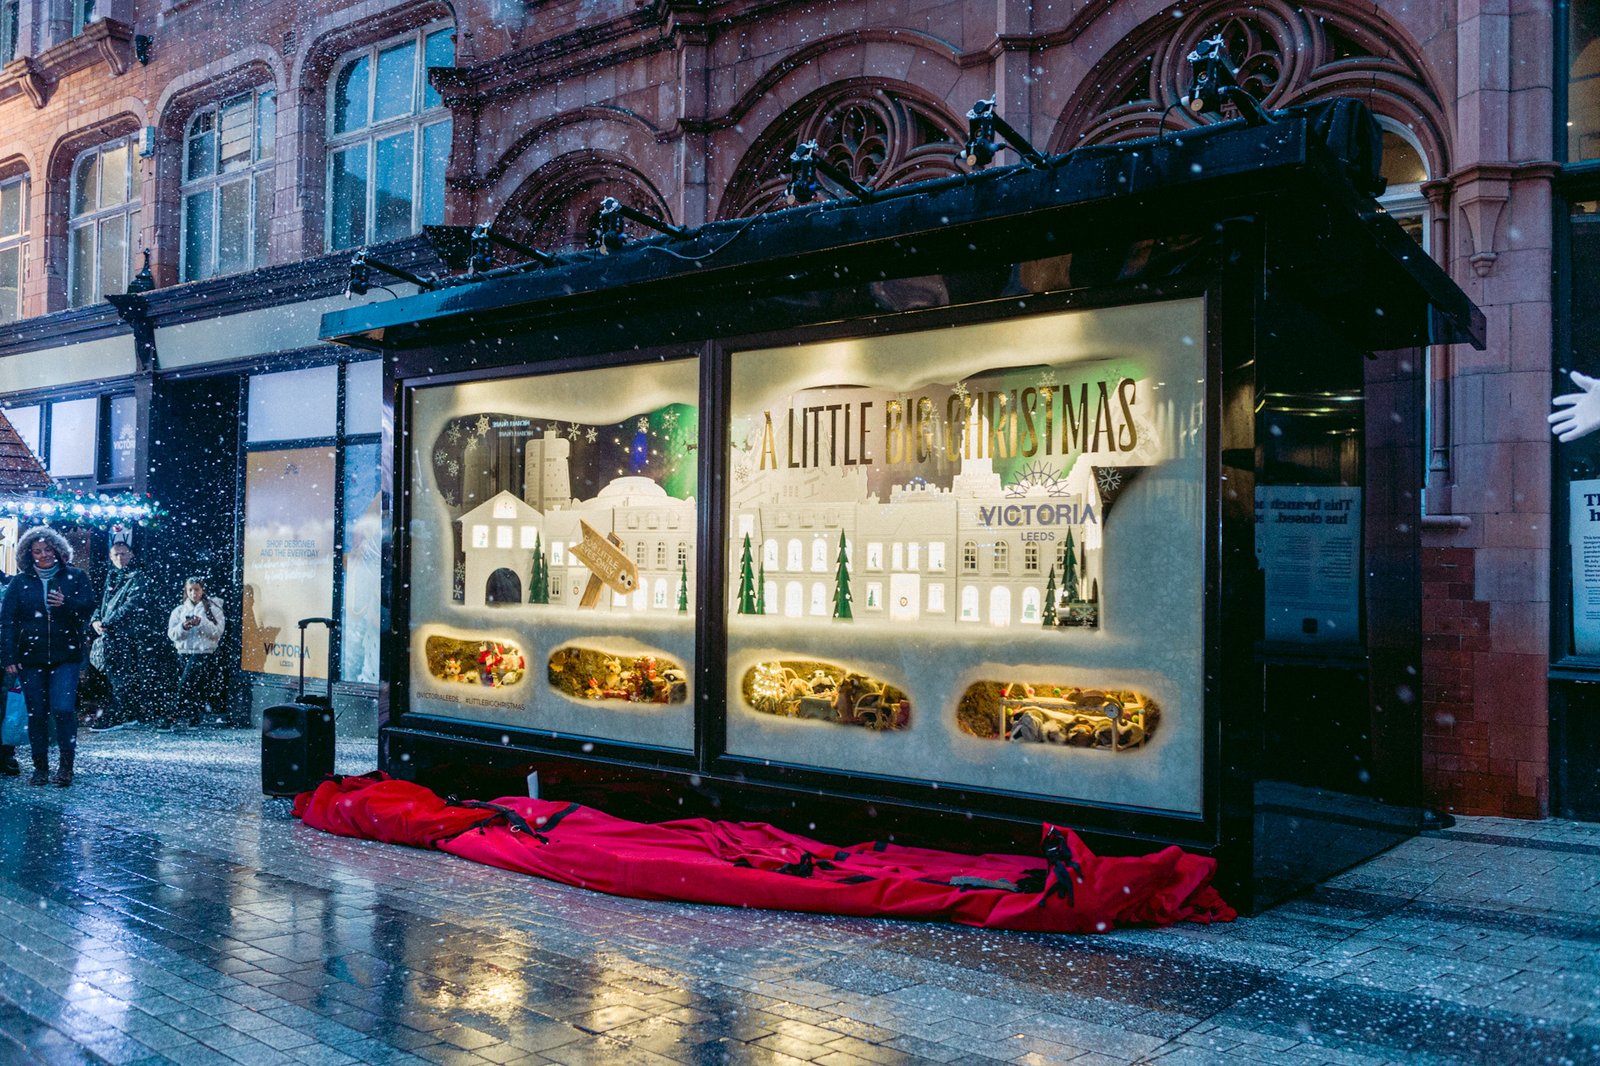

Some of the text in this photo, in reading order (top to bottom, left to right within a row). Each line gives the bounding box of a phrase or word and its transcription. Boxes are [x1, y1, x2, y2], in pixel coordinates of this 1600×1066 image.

[760, 377, 1138, 471] A LITTLE BIG CHRISTMAS
[980, 503, 1097, 526] VICTORIA
[1020, 531, 1055, 542] LEEDS
[263, 642, 311, 660] VICTORA
